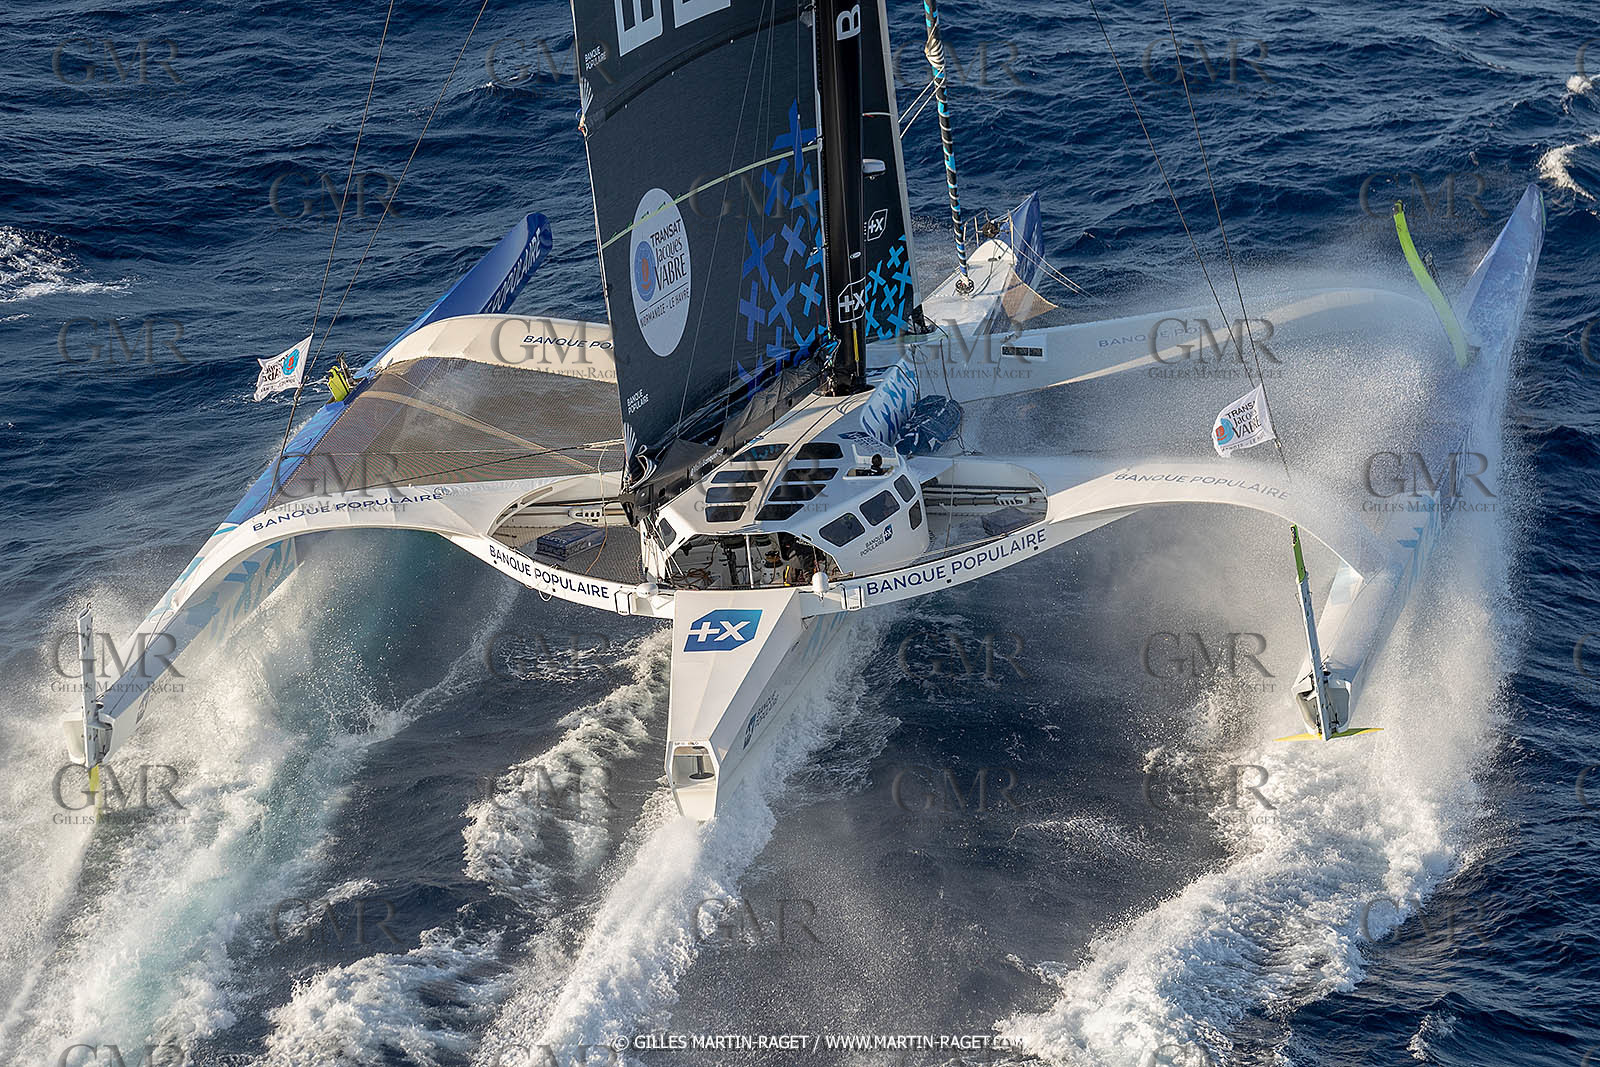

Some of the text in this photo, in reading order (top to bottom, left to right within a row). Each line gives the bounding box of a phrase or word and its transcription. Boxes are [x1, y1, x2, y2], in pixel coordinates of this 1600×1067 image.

[650, 219, 682, 248] TRANSAT
[655, 236, 683, 267] Jacques
[654, 253, 687, 291] VABRE
[523, 335, 588, 349] BANQUE
[1114, 473, 1292, 501] BANQUE POPULAIRE
[253, 492, 444, 532] BANQUE POPULAIRE
[489, 544, 610, 599] BANQUE POPULAIRE
[866, 528, 1047, 596] BANQUE POPULAIRE
